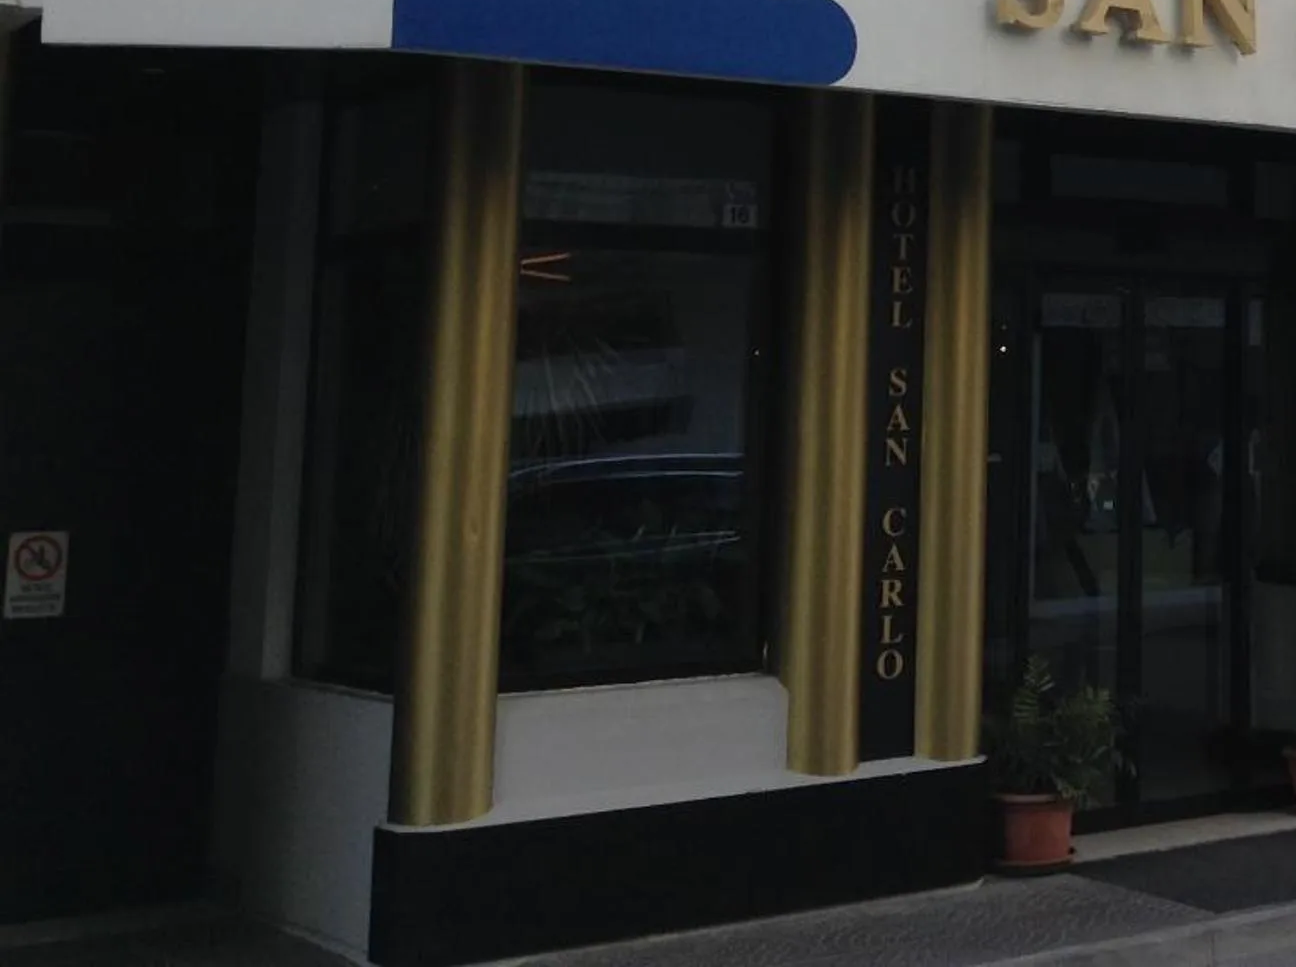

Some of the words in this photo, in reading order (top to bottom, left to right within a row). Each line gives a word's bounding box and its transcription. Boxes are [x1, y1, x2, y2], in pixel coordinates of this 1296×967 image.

[891, 165, 917, 328] HOTEL
[885, 368, 911, 466] SAN
[876, 507, 907, 680] CARLO
